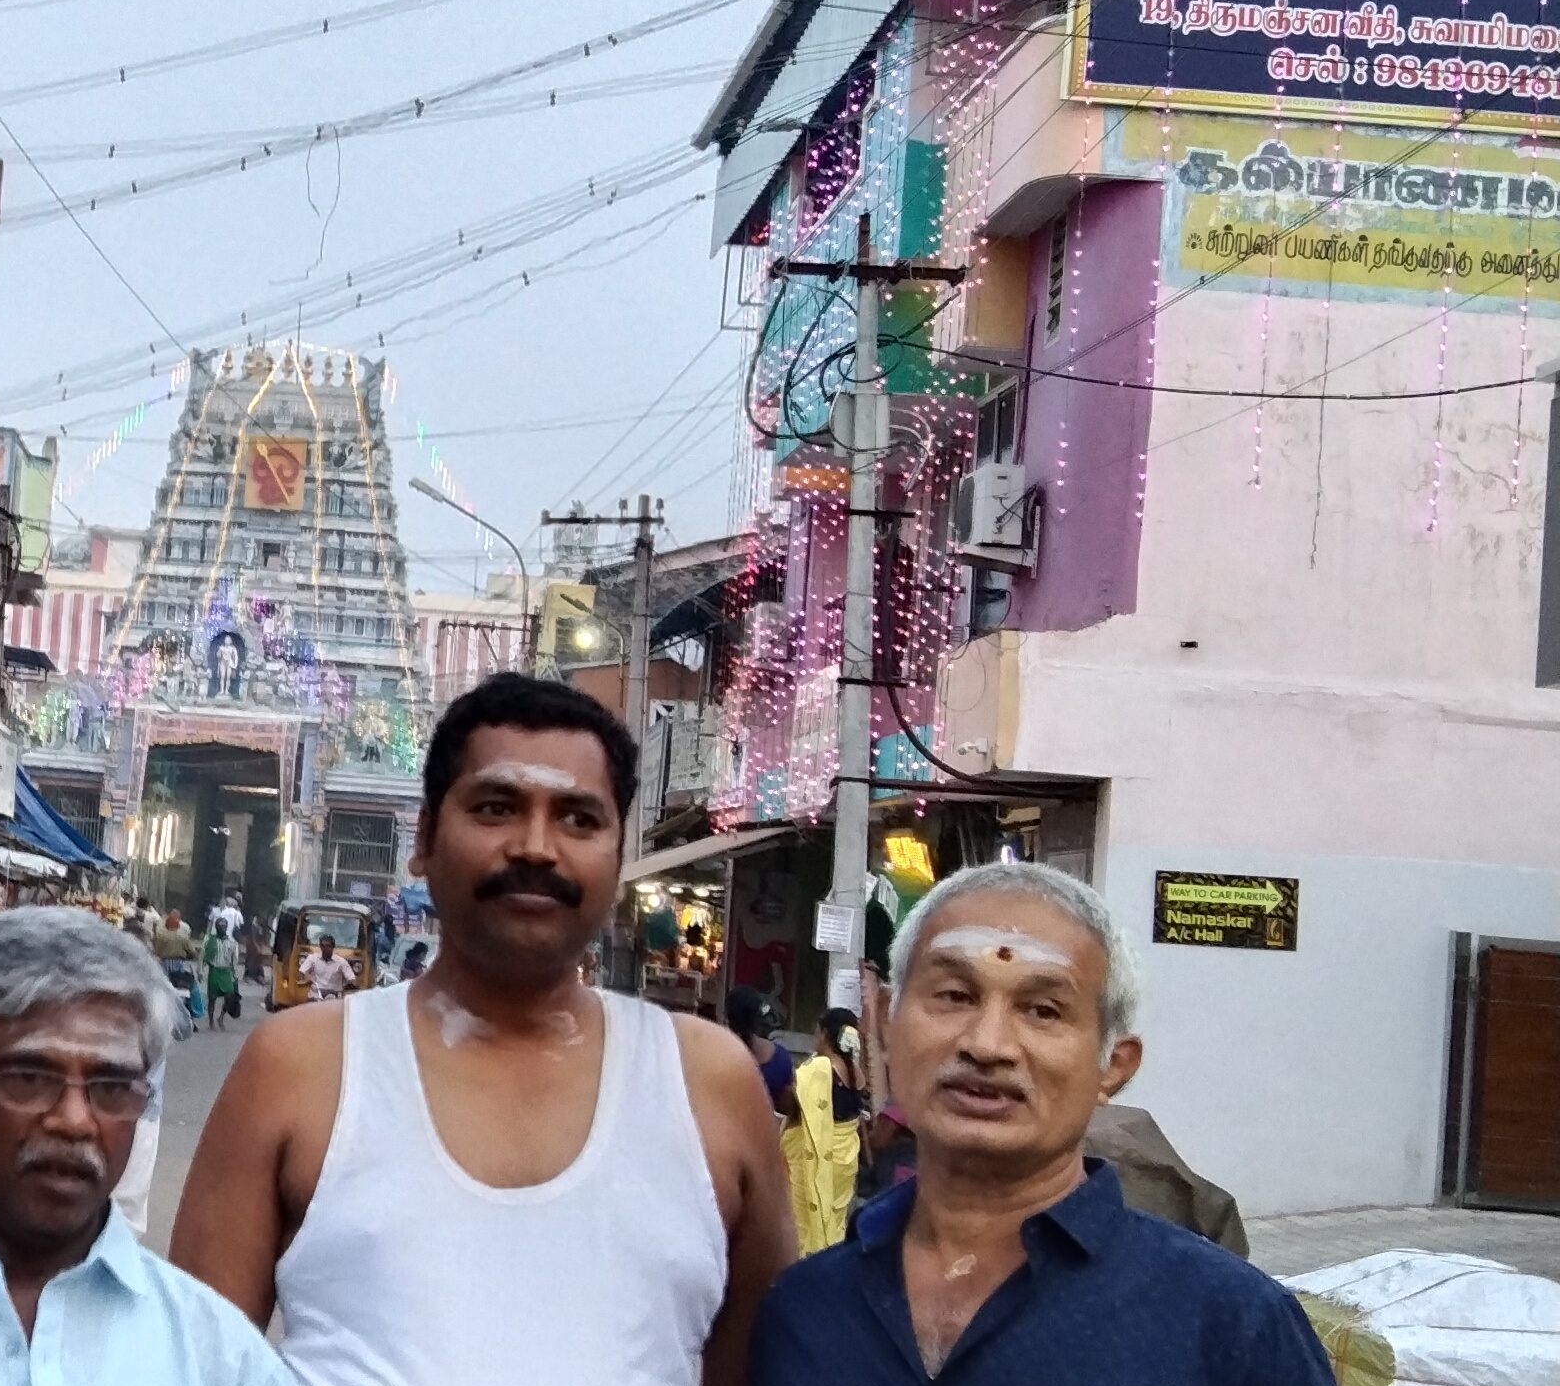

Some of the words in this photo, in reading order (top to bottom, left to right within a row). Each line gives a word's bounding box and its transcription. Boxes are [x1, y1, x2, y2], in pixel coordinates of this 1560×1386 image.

[1345, 0, 1405, 48] வீதி,
[1268, 44, 1348, 83] செல்
[1284, 233, 1369, 268] பயணிகள்
[1170, 886, 1191, 897] WAY
[1193, 888, 1207, 898] TO
[1209, 889, 1232, 900] CAR
[1233, 891, 1279, 902] PARKING
[1166, 909, 1255, 930] Namaskar
[1166, 926, 1192, 943] A/c
[1194, 928, 1224, 943] Hall
